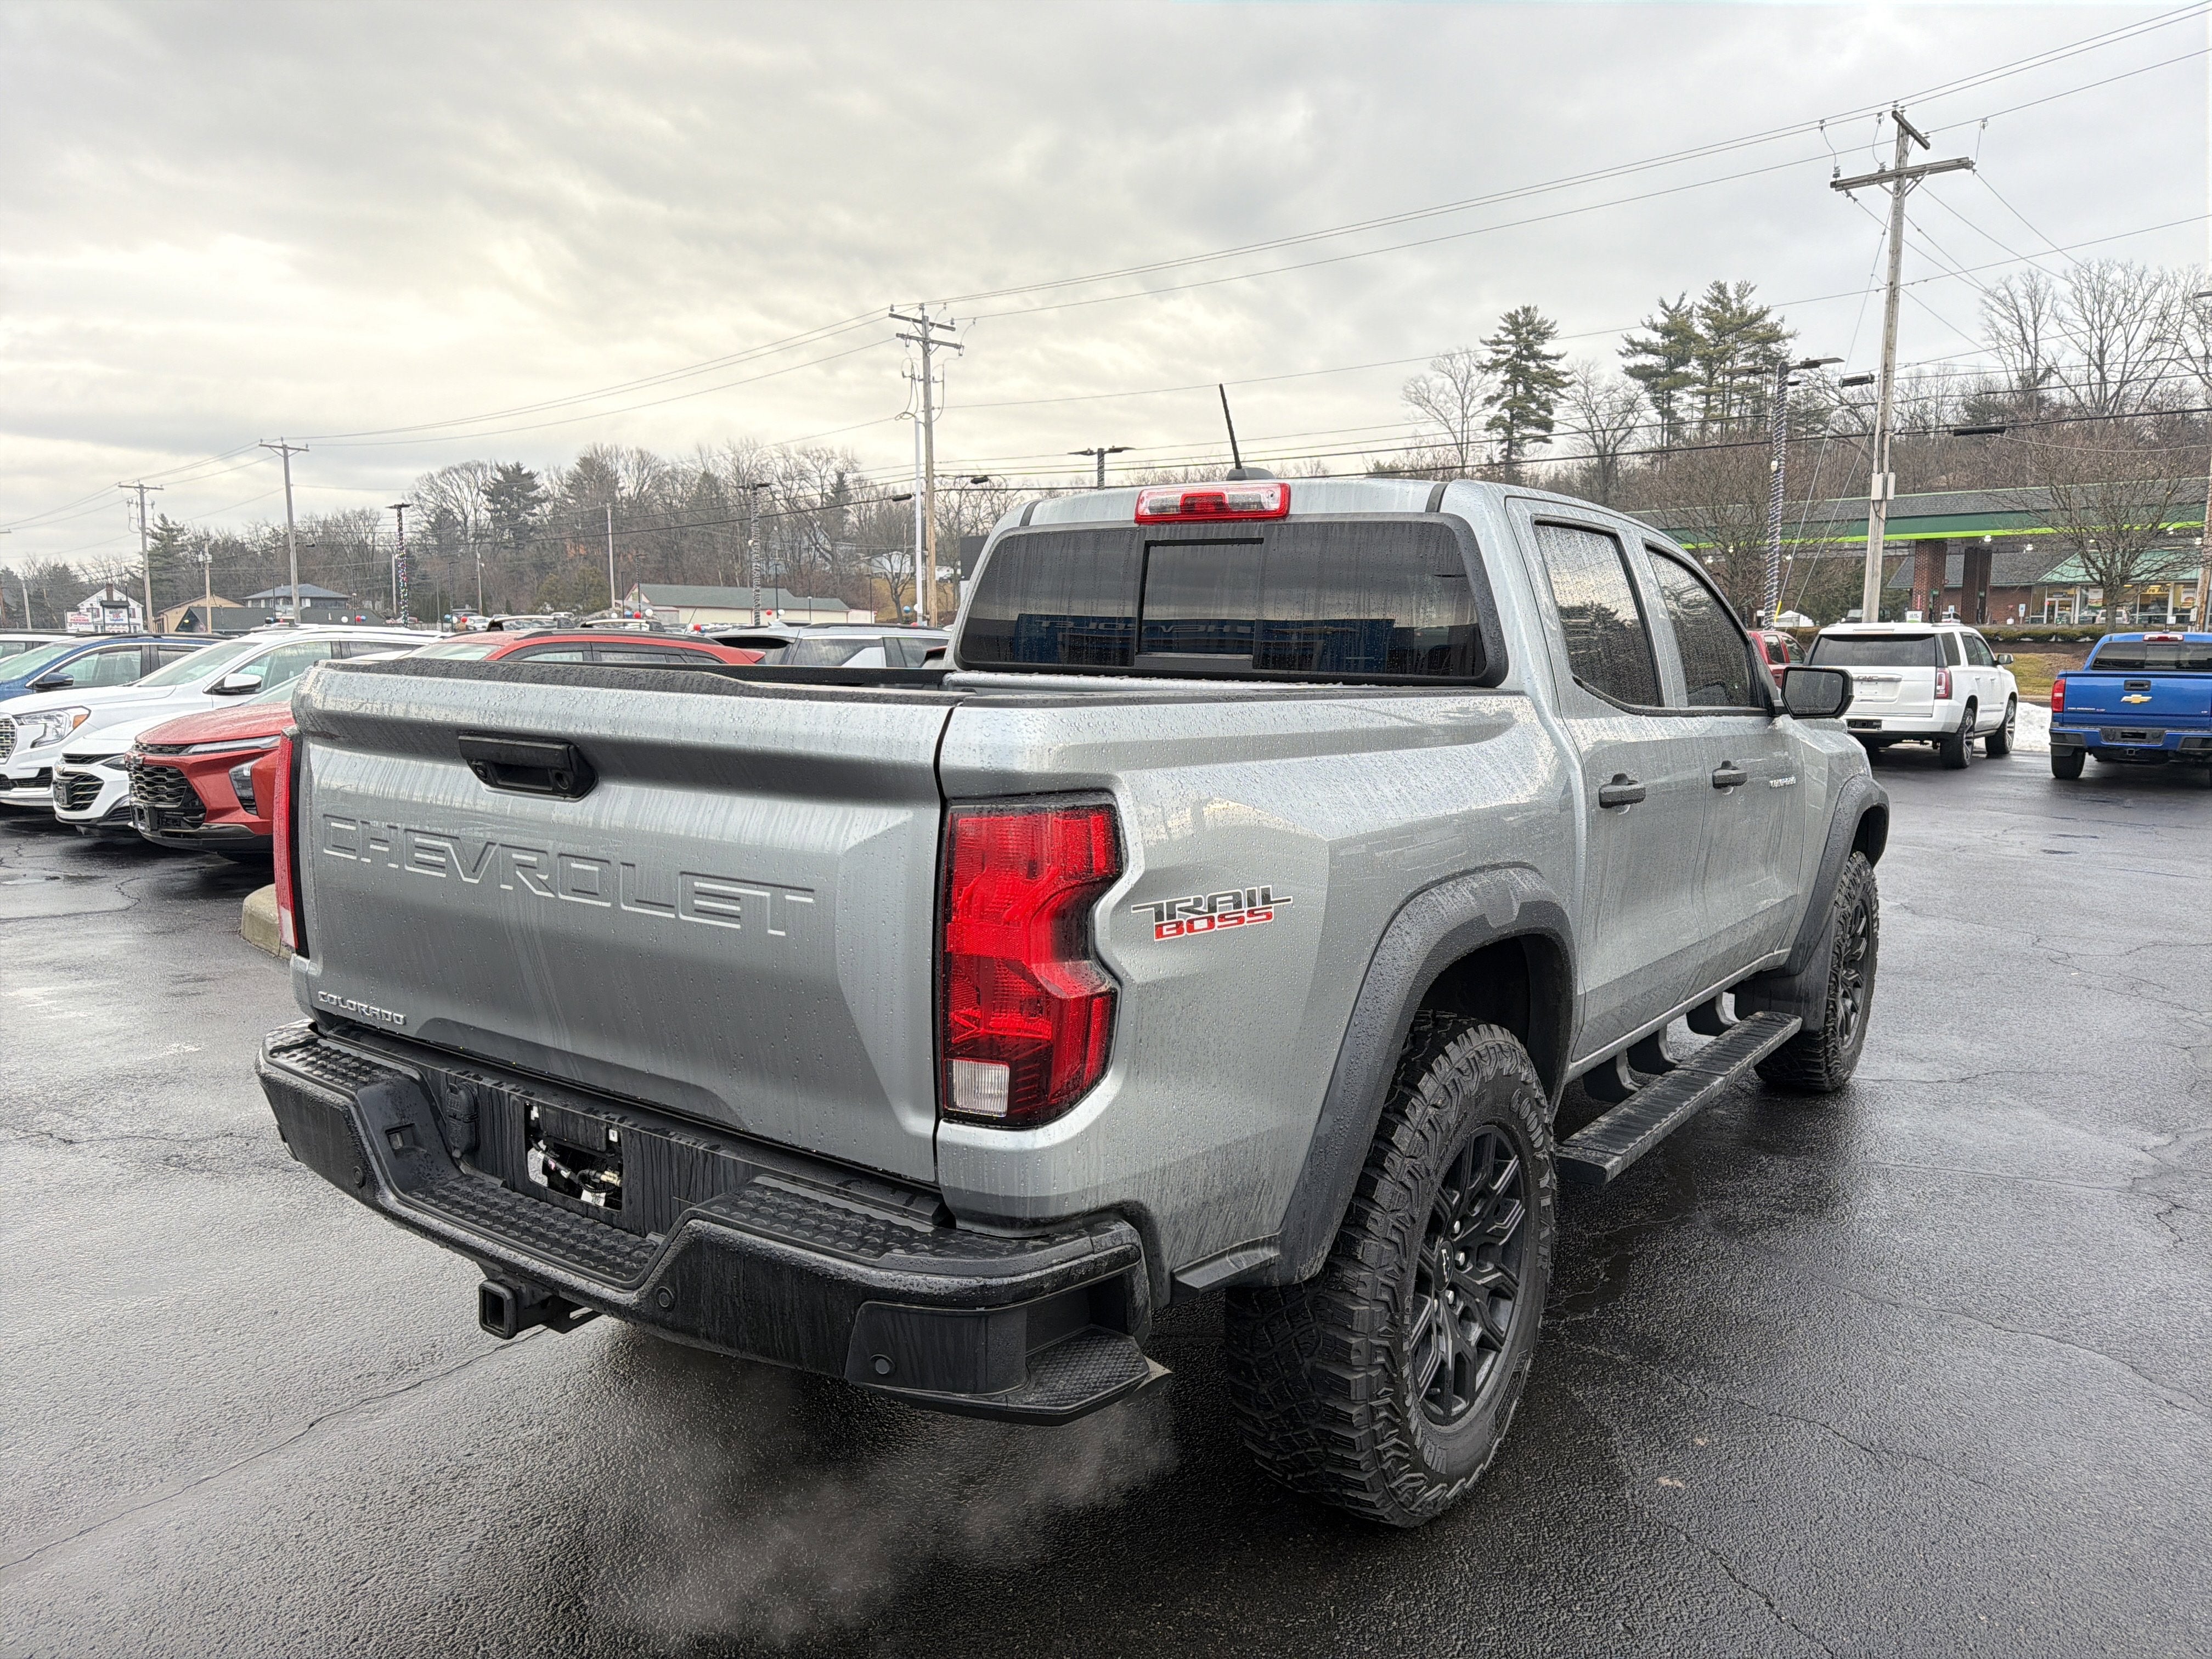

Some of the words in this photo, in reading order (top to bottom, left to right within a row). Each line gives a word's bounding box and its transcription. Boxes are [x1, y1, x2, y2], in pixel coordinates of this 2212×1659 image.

[323, 814, 815, 936] CHEVROLET
[1131, 884, 1293, 923] TRAIL
[1154, 905, 1274, 941] BOSS
[318, 991, 407, 1026] COLORADO
